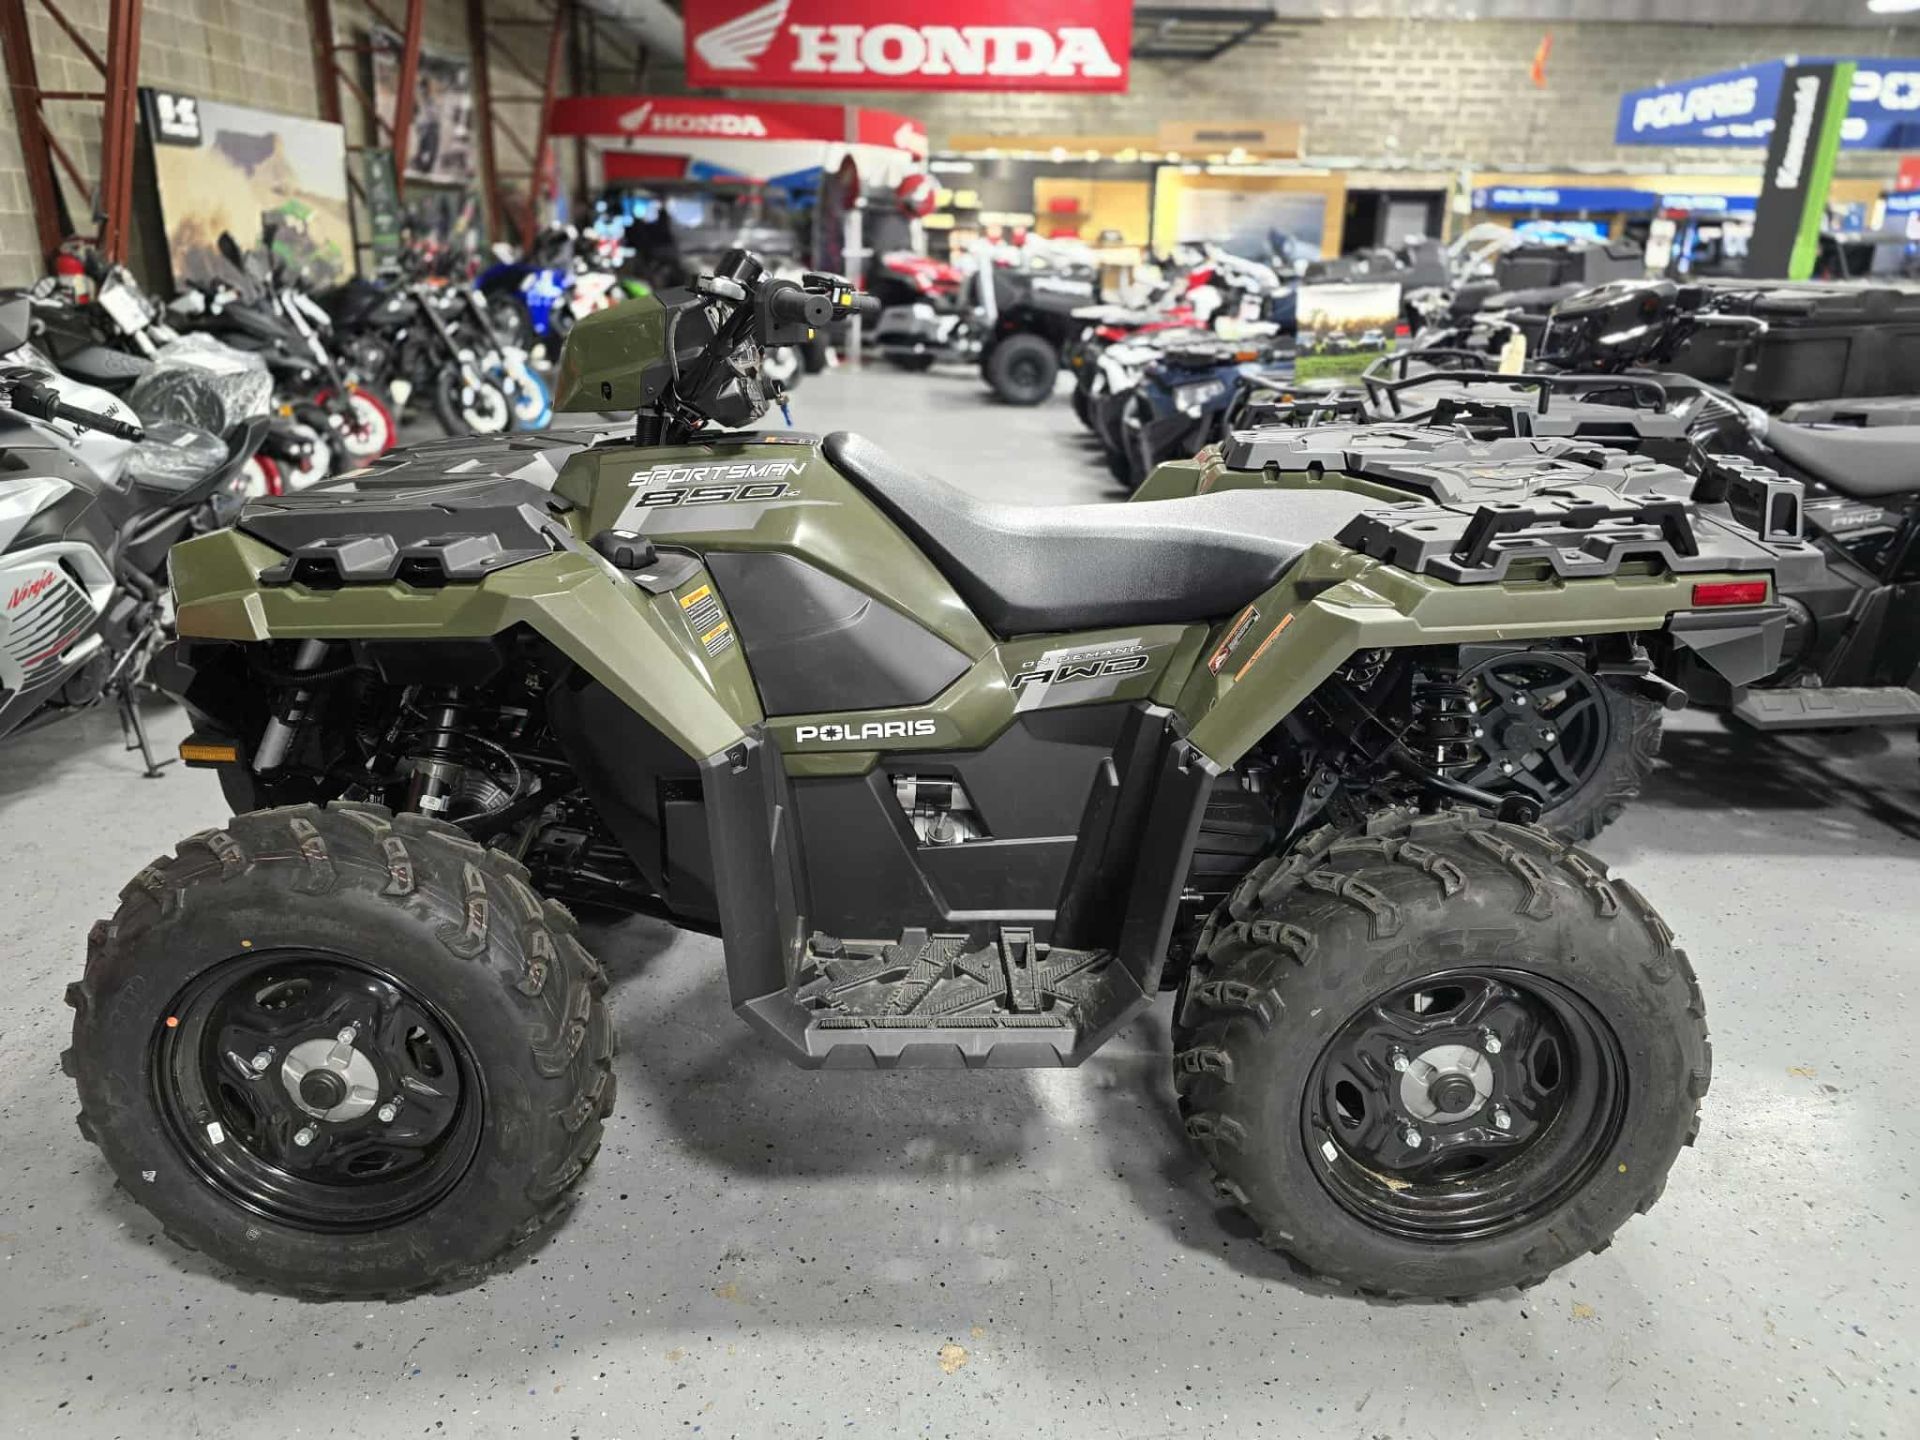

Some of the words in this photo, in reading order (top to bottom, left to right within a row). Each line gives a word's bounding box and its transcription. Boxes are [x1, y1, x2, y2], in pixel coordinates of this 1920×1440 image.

[789, 23, 1122, 77] HONDA
[651, 114, 767, 137] HONDA
[628, 462, 807, 487] SPORTSMAN
[634, 481, 789, 508] 850
[6, 568, 57, 610] Ninja
[1008, 655, 1149, 690] AWD
[1022, 658, 1051, 668] ON
[796, 719, 937, 743] POLARIS
